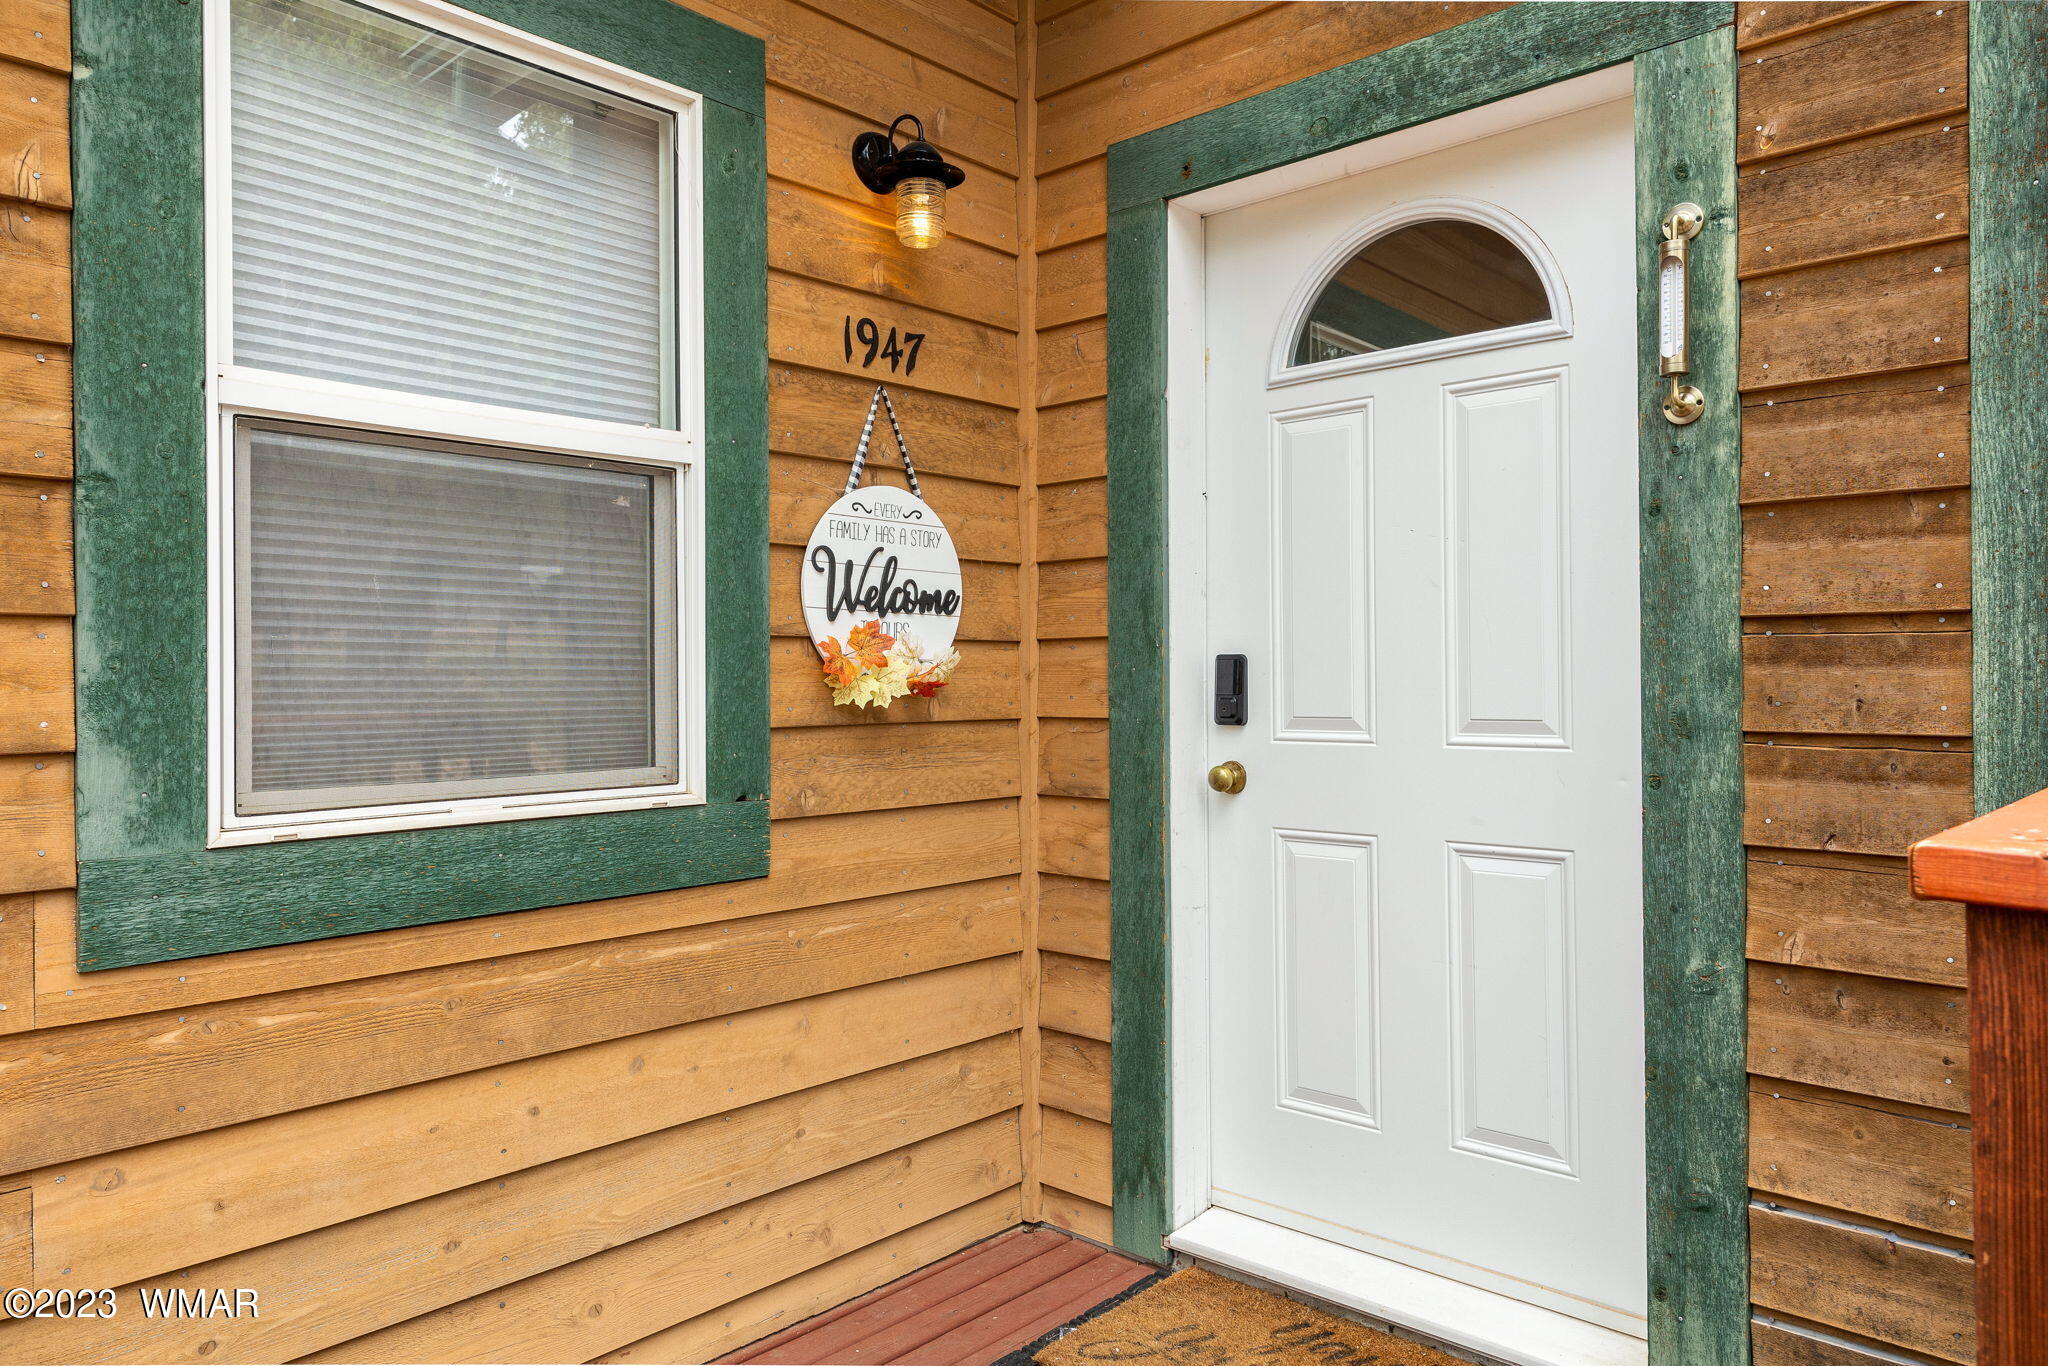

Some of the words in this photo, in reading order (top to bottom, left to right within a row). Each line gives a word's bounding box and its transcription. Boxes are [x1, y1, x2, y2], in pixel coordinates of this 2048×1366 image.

[844, 315, 926, 377] 1947
[874, 502, 902, 519] EVERY
[829, 519, 870, 541] FAMILY
[876, 525, 896, 544] HAS
[899, 528, 906, 545] A
[911, 529, 942, 549] STORY
[811, 545, 961, 622] Welcome
